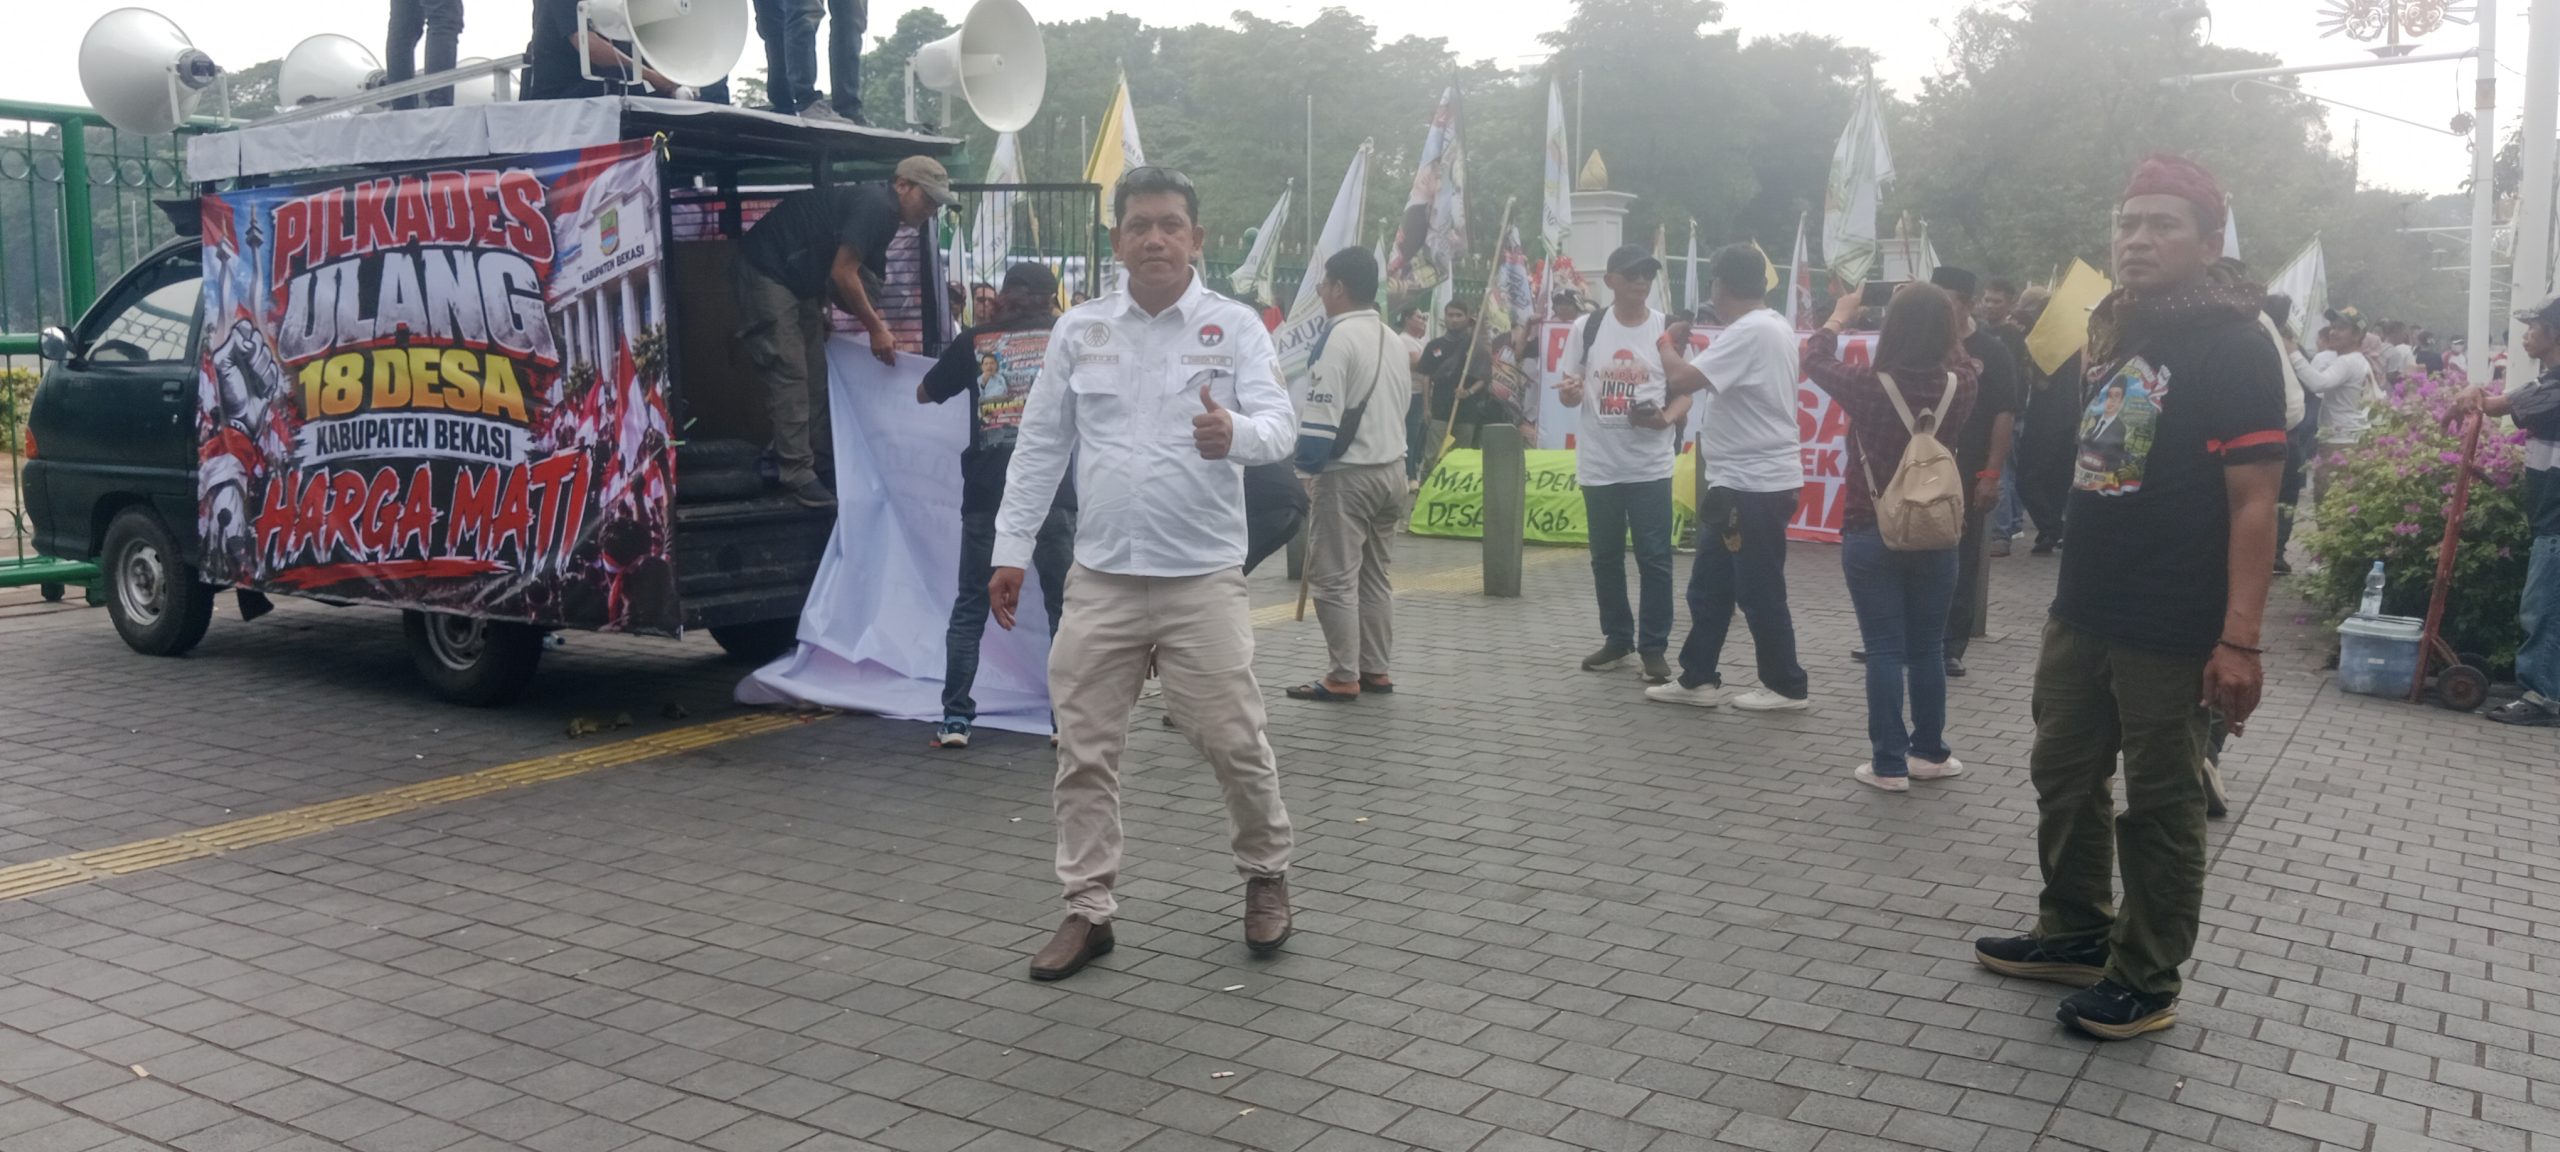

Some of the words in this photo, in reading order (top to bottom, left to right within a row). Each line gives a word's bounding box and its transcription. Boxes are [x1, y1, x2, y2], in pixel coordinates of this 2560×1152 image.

[271, 169, 555, 291] PILKADES
[582, 258, 615, 284] KABUPATEN
[616, 244, 645, 267] BEKASI
[277, 249, 560, 362] ULANG
[299, 352, 365, 420] 18
[371, 347, 529, 422] DESA
[316, 418, 428, 456] KABUPATEN
[434, 420, 512, 461] BEKASI
[252, 461, 444, 580] HARGA
[446, 448, 594, 580] MATI
[1526, 507, 1577, 533] Kab.
